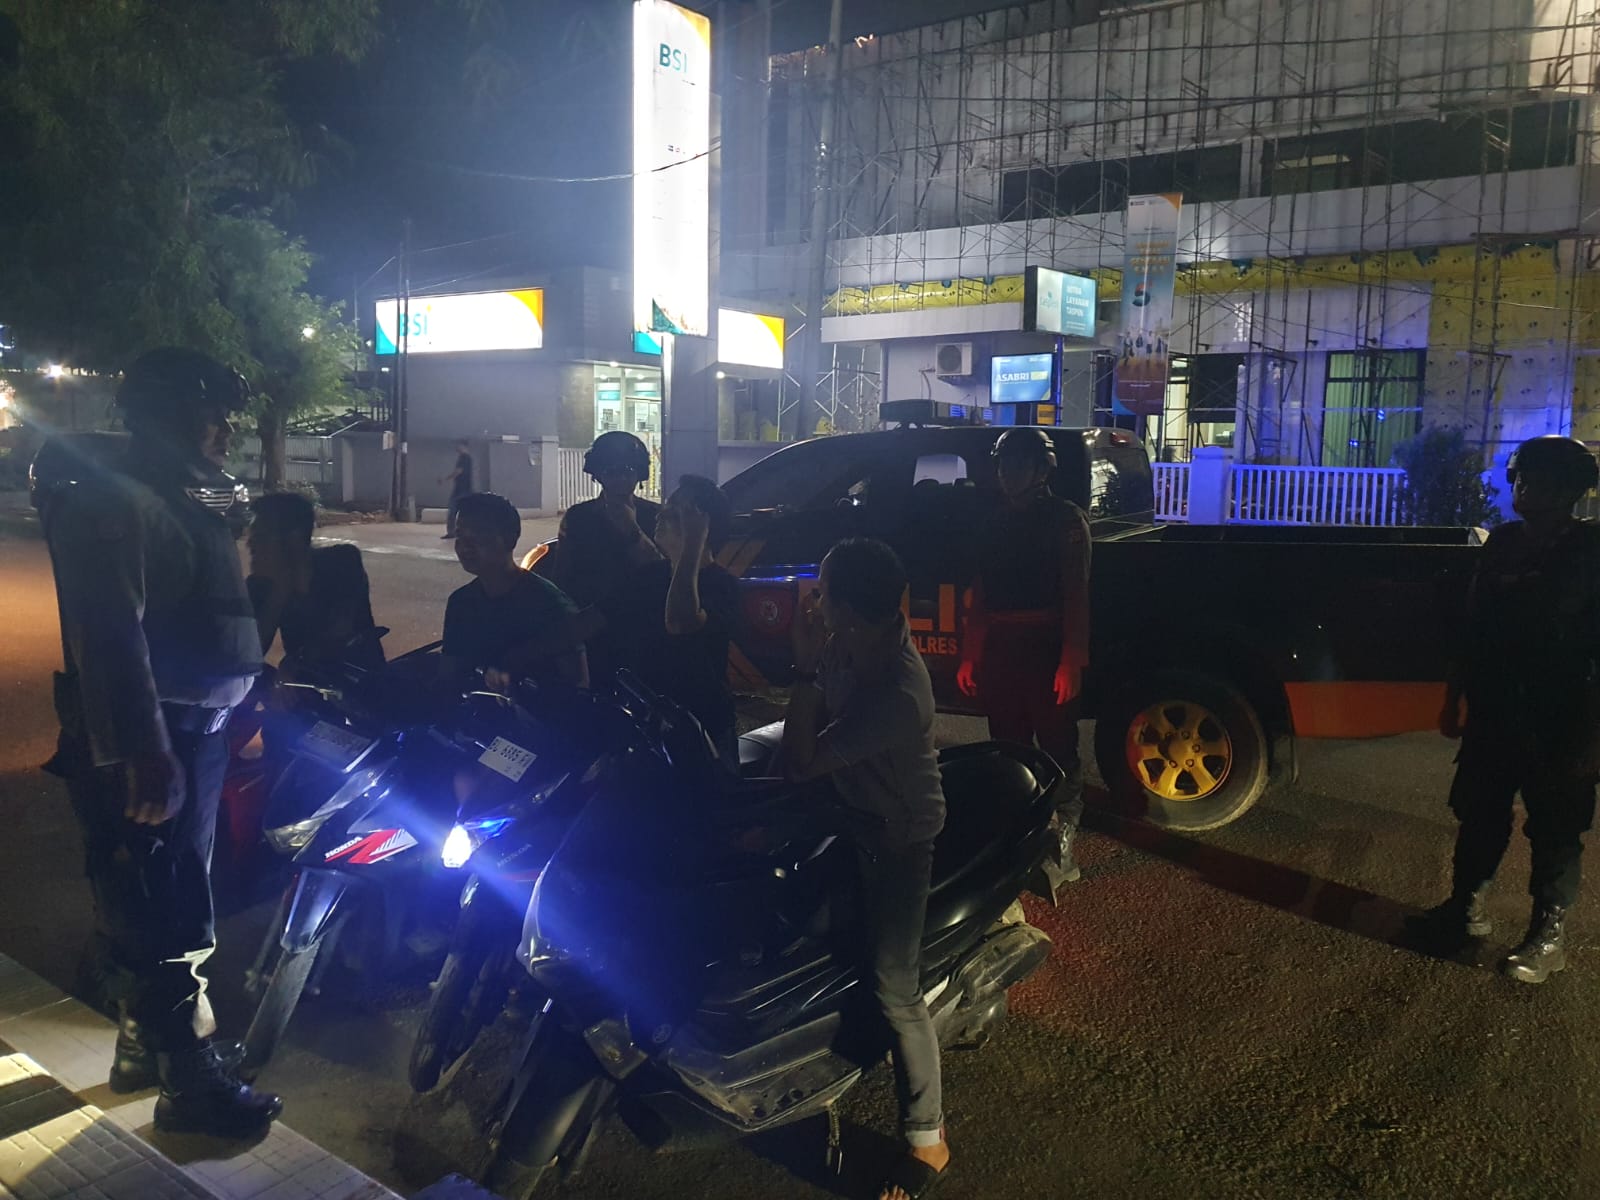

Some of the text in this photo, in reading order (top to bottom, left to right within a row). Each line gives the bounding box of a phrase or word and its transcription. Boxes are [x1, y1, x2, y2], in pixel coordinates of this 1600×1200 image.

[659, 43, 687, 73] BSI
[399, 312, 428, 337] BSI
[996, 372, 1030, 382] ASABRI
[325, 836, 364, 859] HONDA
